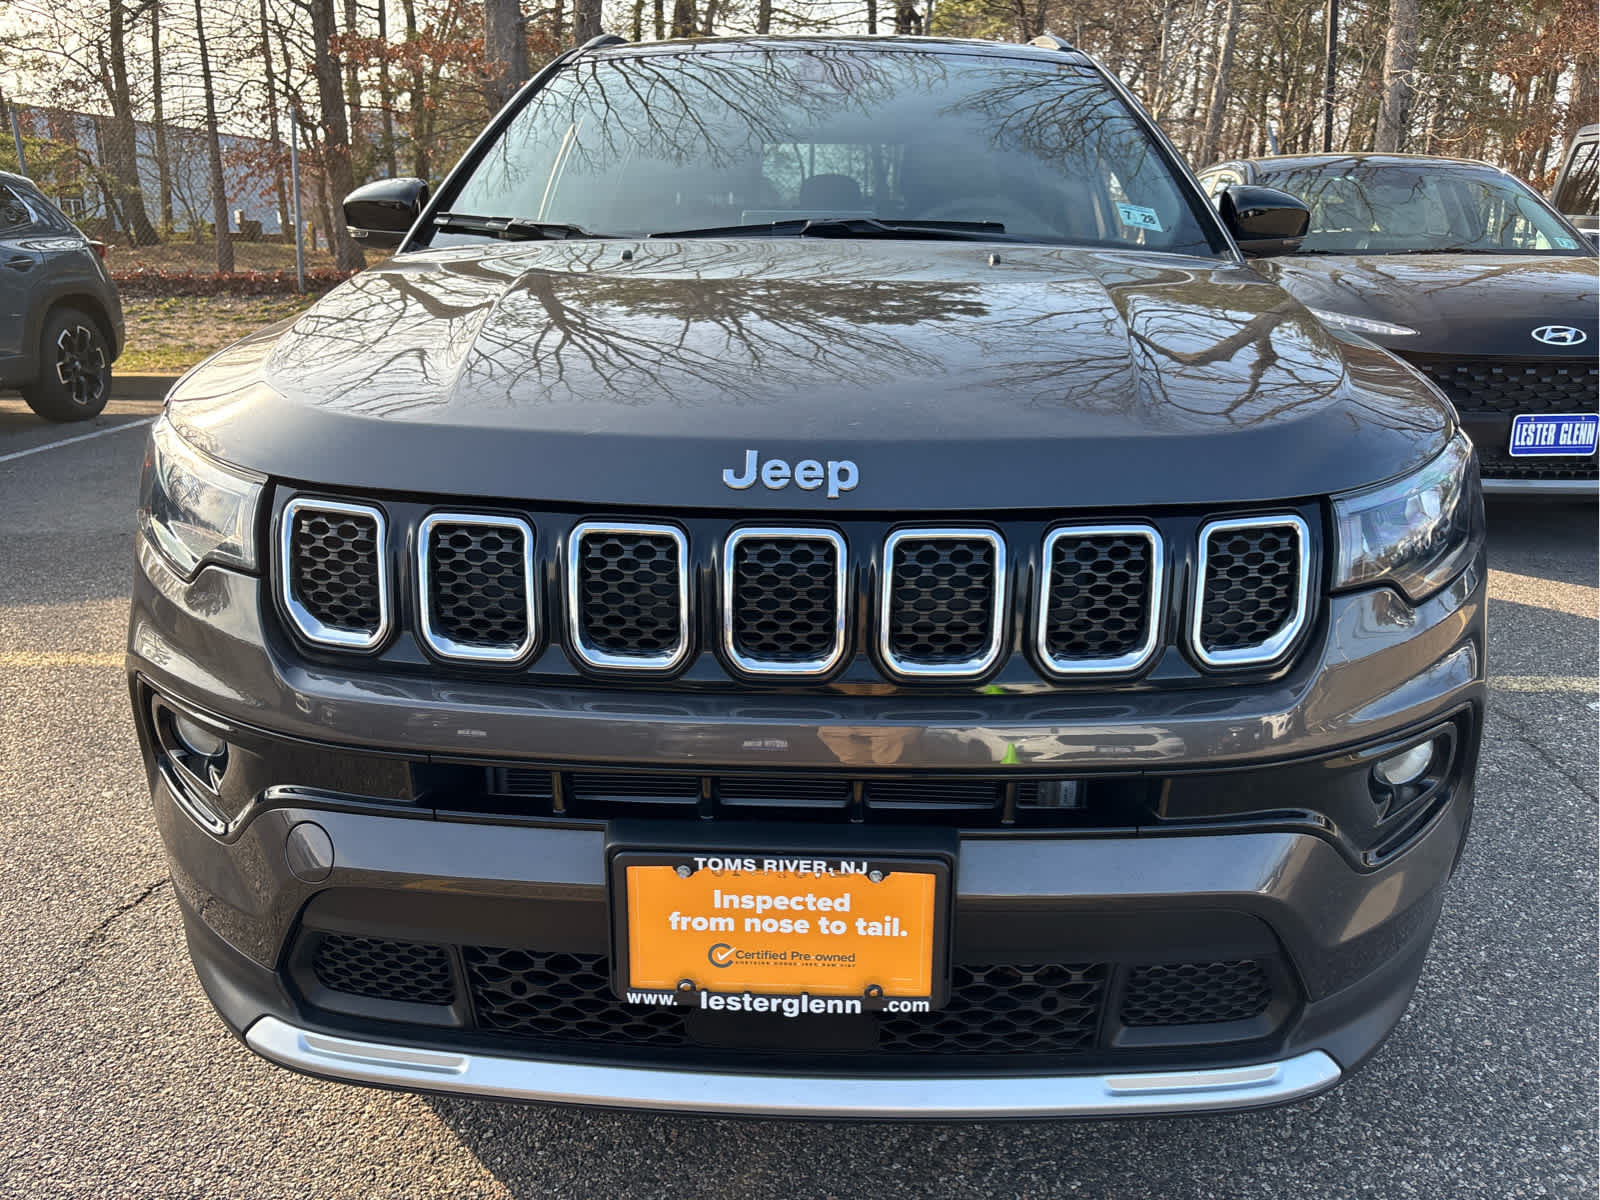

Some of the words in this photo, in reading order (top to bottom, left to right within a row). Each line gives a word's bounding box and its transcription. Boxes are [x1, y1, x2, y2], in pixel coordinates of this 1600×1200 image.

[1514, 423, 1557, 446] LESTER
[1559, 423, 1596, 445] GLENN
[722, 449, 860, 498] Jeep
[694, 857, 757, 871] TOMS
[763, 859, 835, 875] RIVER,
[840, 861, 868, 875] NJ
[713, 889, 851, 914] Inspected
[668, 911, 735, 932] from
[744, 917, 810, 934] nose
[817, 916, 848, 935] to
[855, 915, 908, 937] tail.
[735, 950, 787, 961] Certified
[626, 992, 678, 1006] www.
[700, 991, 862, 1018] lesterglenn
[882, 1000, 930, 1013] .com
